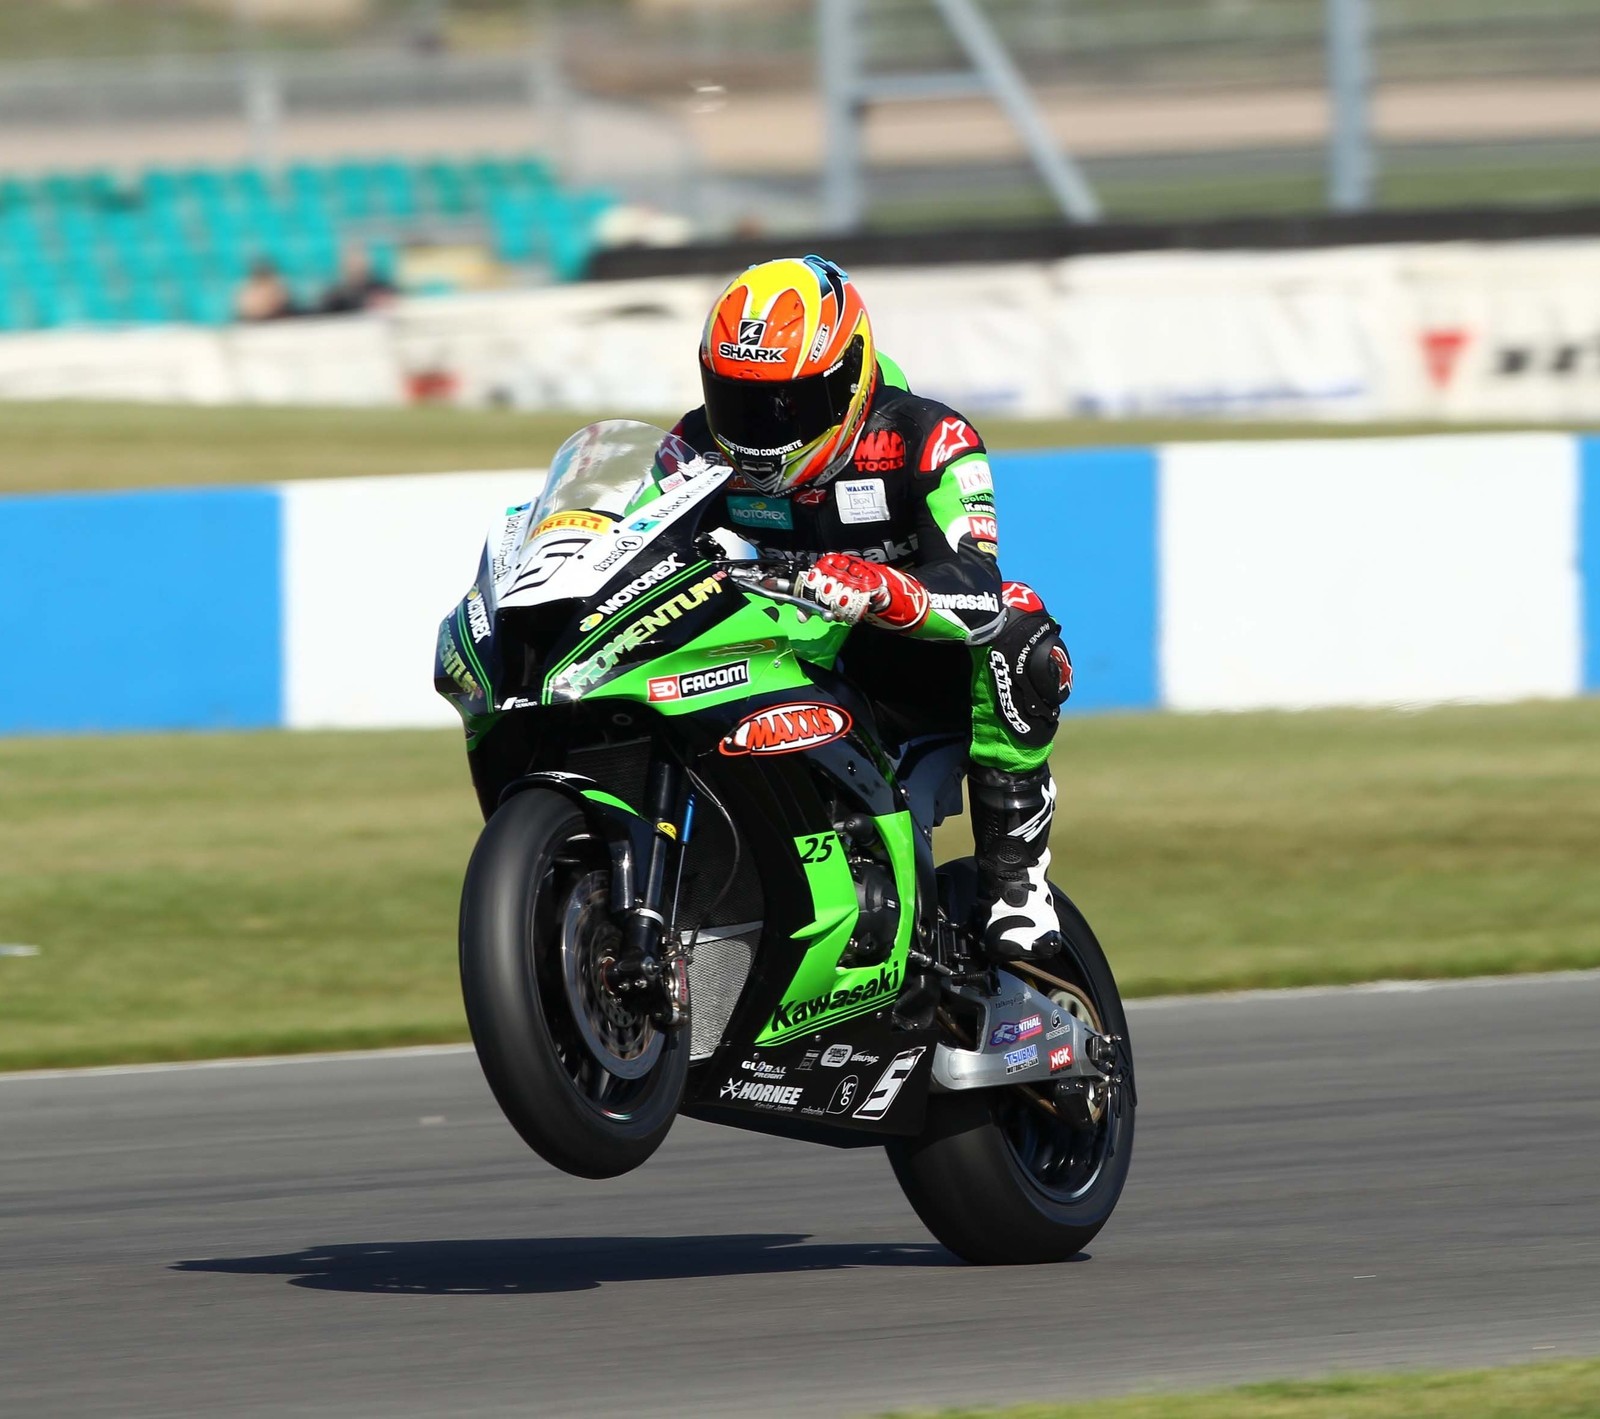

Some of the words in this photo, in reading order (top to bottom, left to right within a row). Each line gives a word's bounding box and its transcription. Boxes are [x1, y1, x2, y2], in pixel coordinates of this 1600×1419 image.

[719, 343, 787, 361] SHARK
[760, 439, 803, 456] CONCRETE
[854, 431, 903, 461] MAC
[854, 459, 904, 472] TOOLS
[732, 509, 786, 520] MOTOREX
[597, 552, 686, 615] MOTOREX
[1016, 645, 1031, 675] AHEAD
[681, 664, 747, 694] FACOM
[747, 708, 836, 750] MAXXIS
[801, 835, 835, 863] 25
[771, 961, 899, 1032] Kawasaki
[1004, 1045, 1037, 1066] TSUBAKI
[1050, 1047, 1070, 1069] NGK
[741, 1060, 787, 1074] GLOBAL
[753, 1071, 785, 1080] FREIGHT
[738, 1082, 803, 1105] HORNEE
